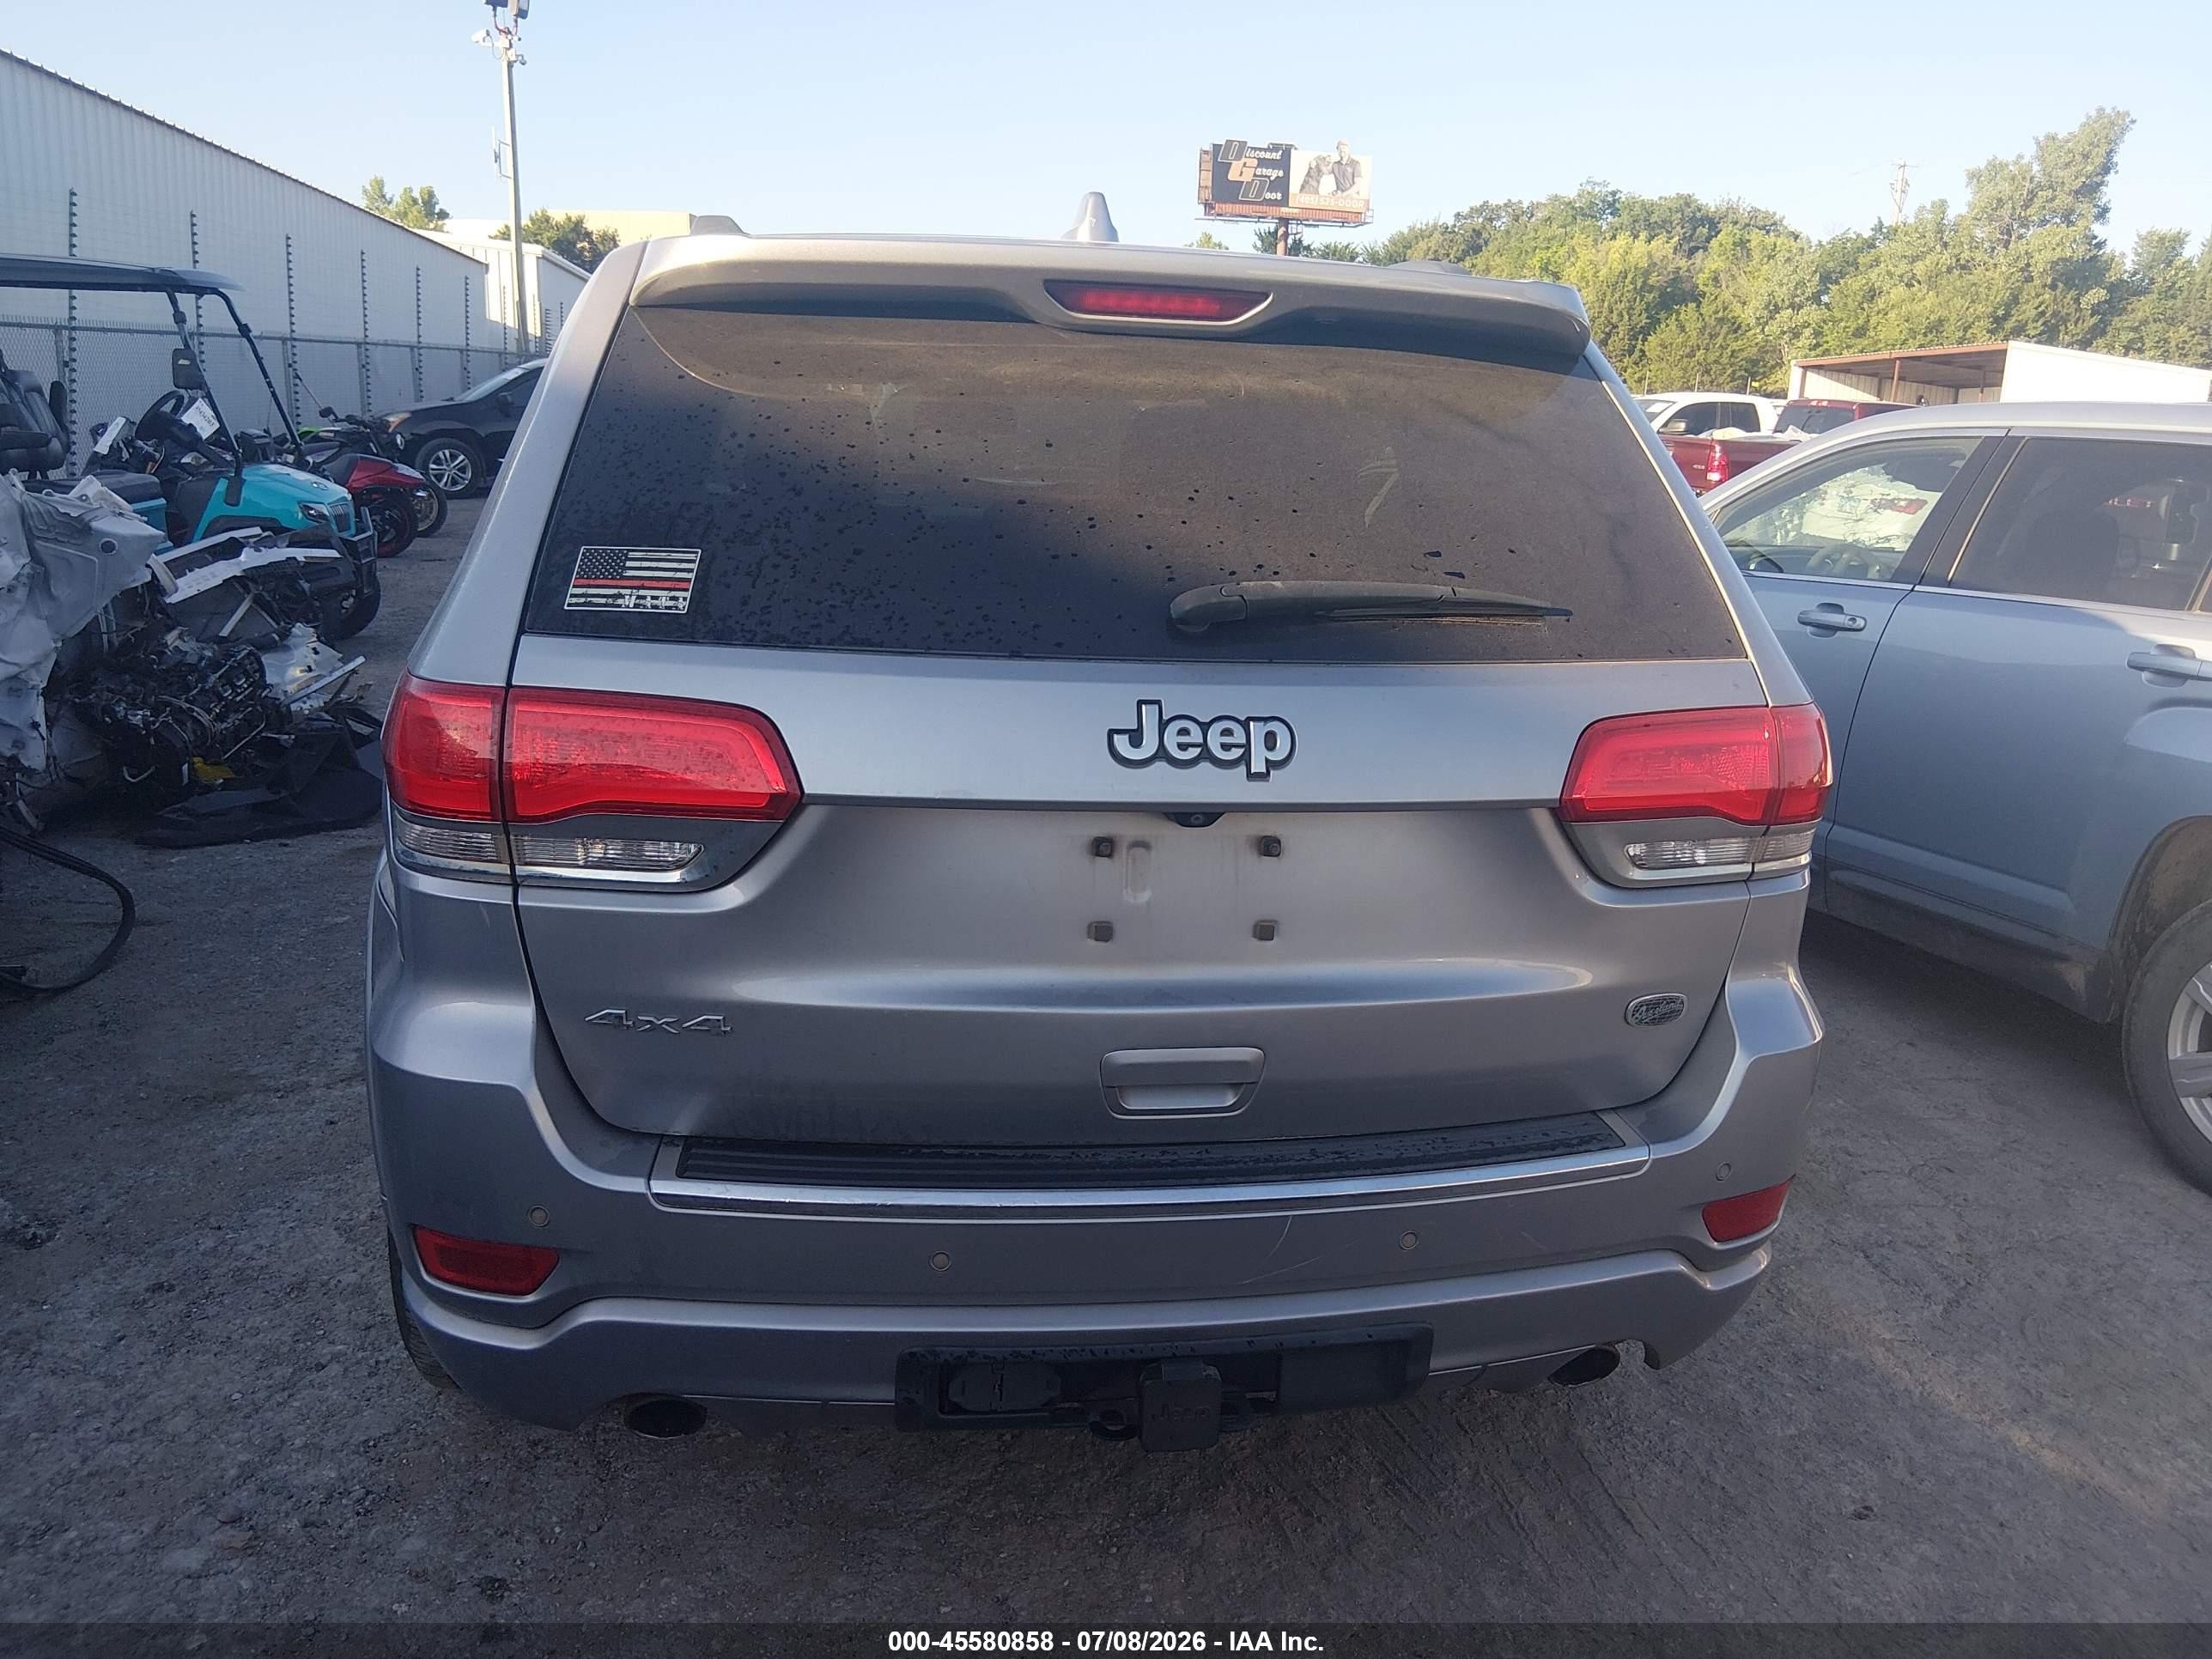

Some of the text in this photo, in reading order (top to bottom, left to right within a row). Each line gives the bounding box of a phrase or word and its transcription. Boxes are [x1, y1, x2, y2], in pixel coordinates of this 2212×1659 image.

[1218, 139, 1283, 162] Discount
[1228, 158, 1284, 182] Garage
[1238, 178, 1282, 201] Door
[1108, 700, 1297, 781] Jeep
